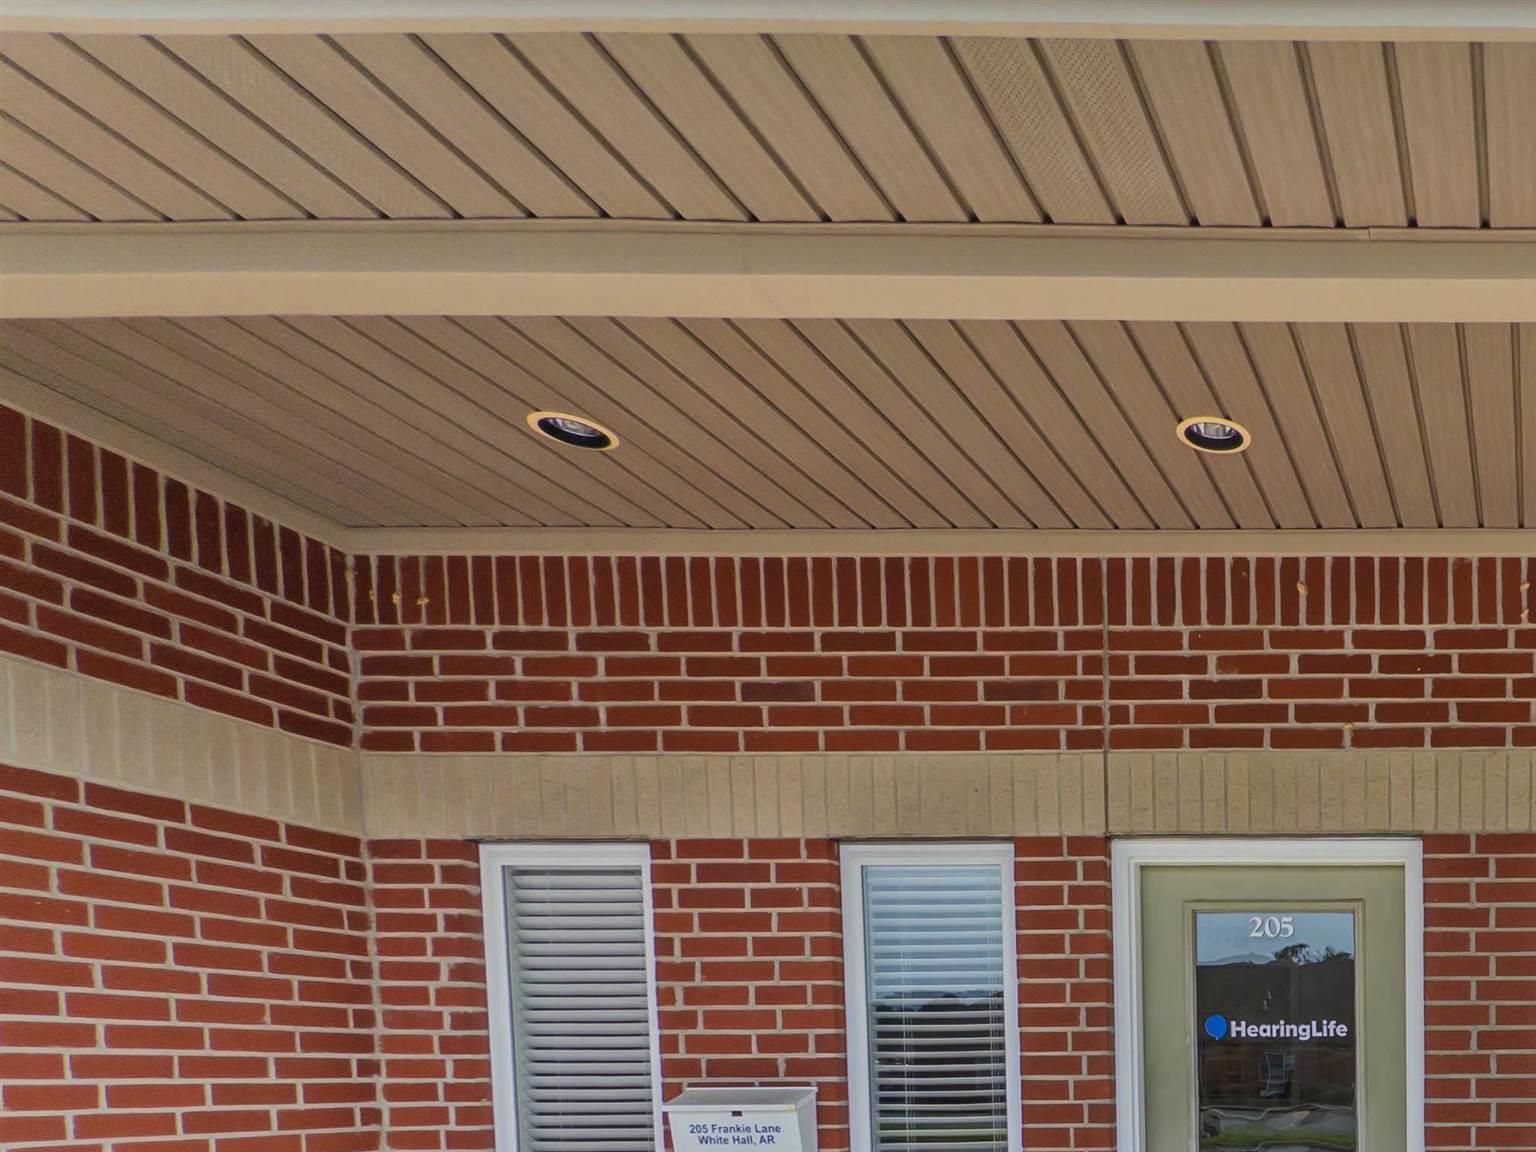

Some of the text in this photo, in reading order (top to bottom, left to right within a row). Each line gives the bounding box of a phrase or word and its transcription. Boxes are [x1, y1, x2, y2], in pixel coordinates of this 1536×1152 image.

[1249, 915, 1295, 938] 205
[1230, 1019, 1348, 1041] HearingLife
[689, 1124, 782, 1134] 205 Frankie Lane
[698, 1135, 775, 1146] White Hall, AR
